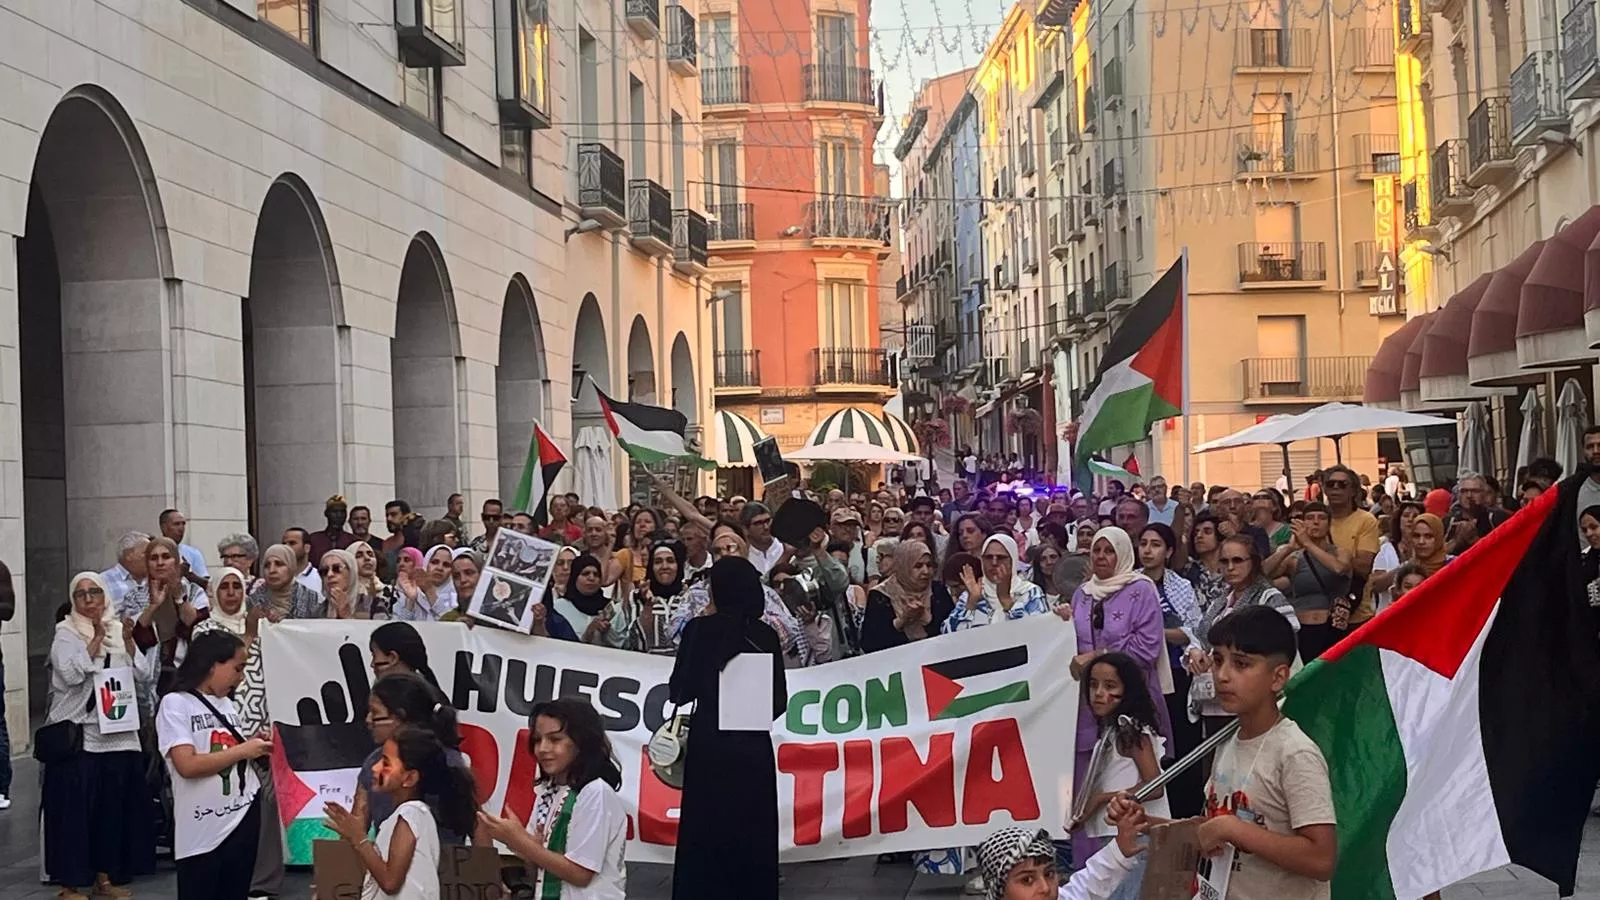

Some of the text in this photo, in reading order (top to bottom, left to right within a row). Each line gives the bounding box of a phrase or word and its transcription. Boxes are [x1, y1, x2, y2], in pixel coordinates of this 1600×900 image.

[1377, 179, 1395, 291] HOSTAL
[452, 650, 908, 735] HUESC CON
[319, 784, 341, 795] Free
